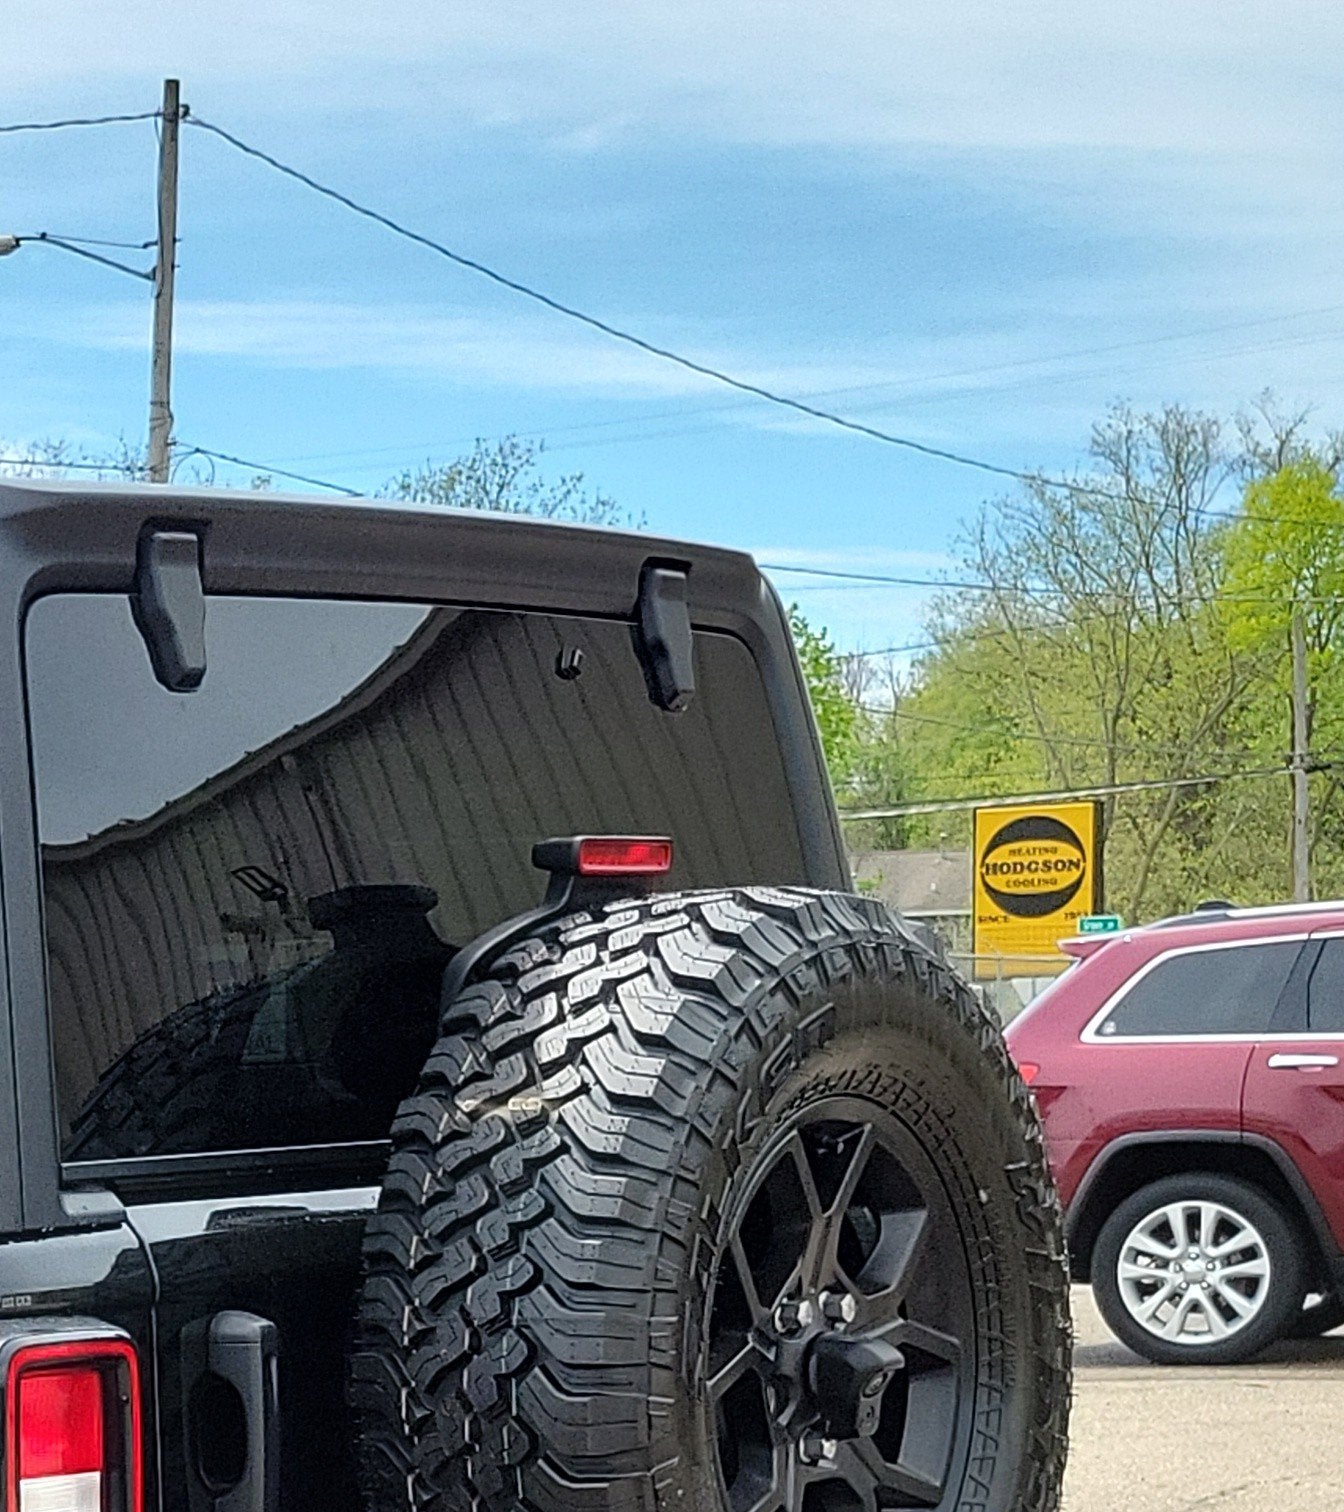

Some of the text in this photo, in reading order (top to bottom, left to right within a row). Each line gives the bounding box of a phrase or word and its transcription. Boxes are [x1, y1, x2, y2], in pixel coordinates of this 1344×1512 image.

[1008, 846, 1058, 857] HEATING
[984, 858, 1081, 876] HODGSON
[1005, 878, 1058, 889] COOLING
